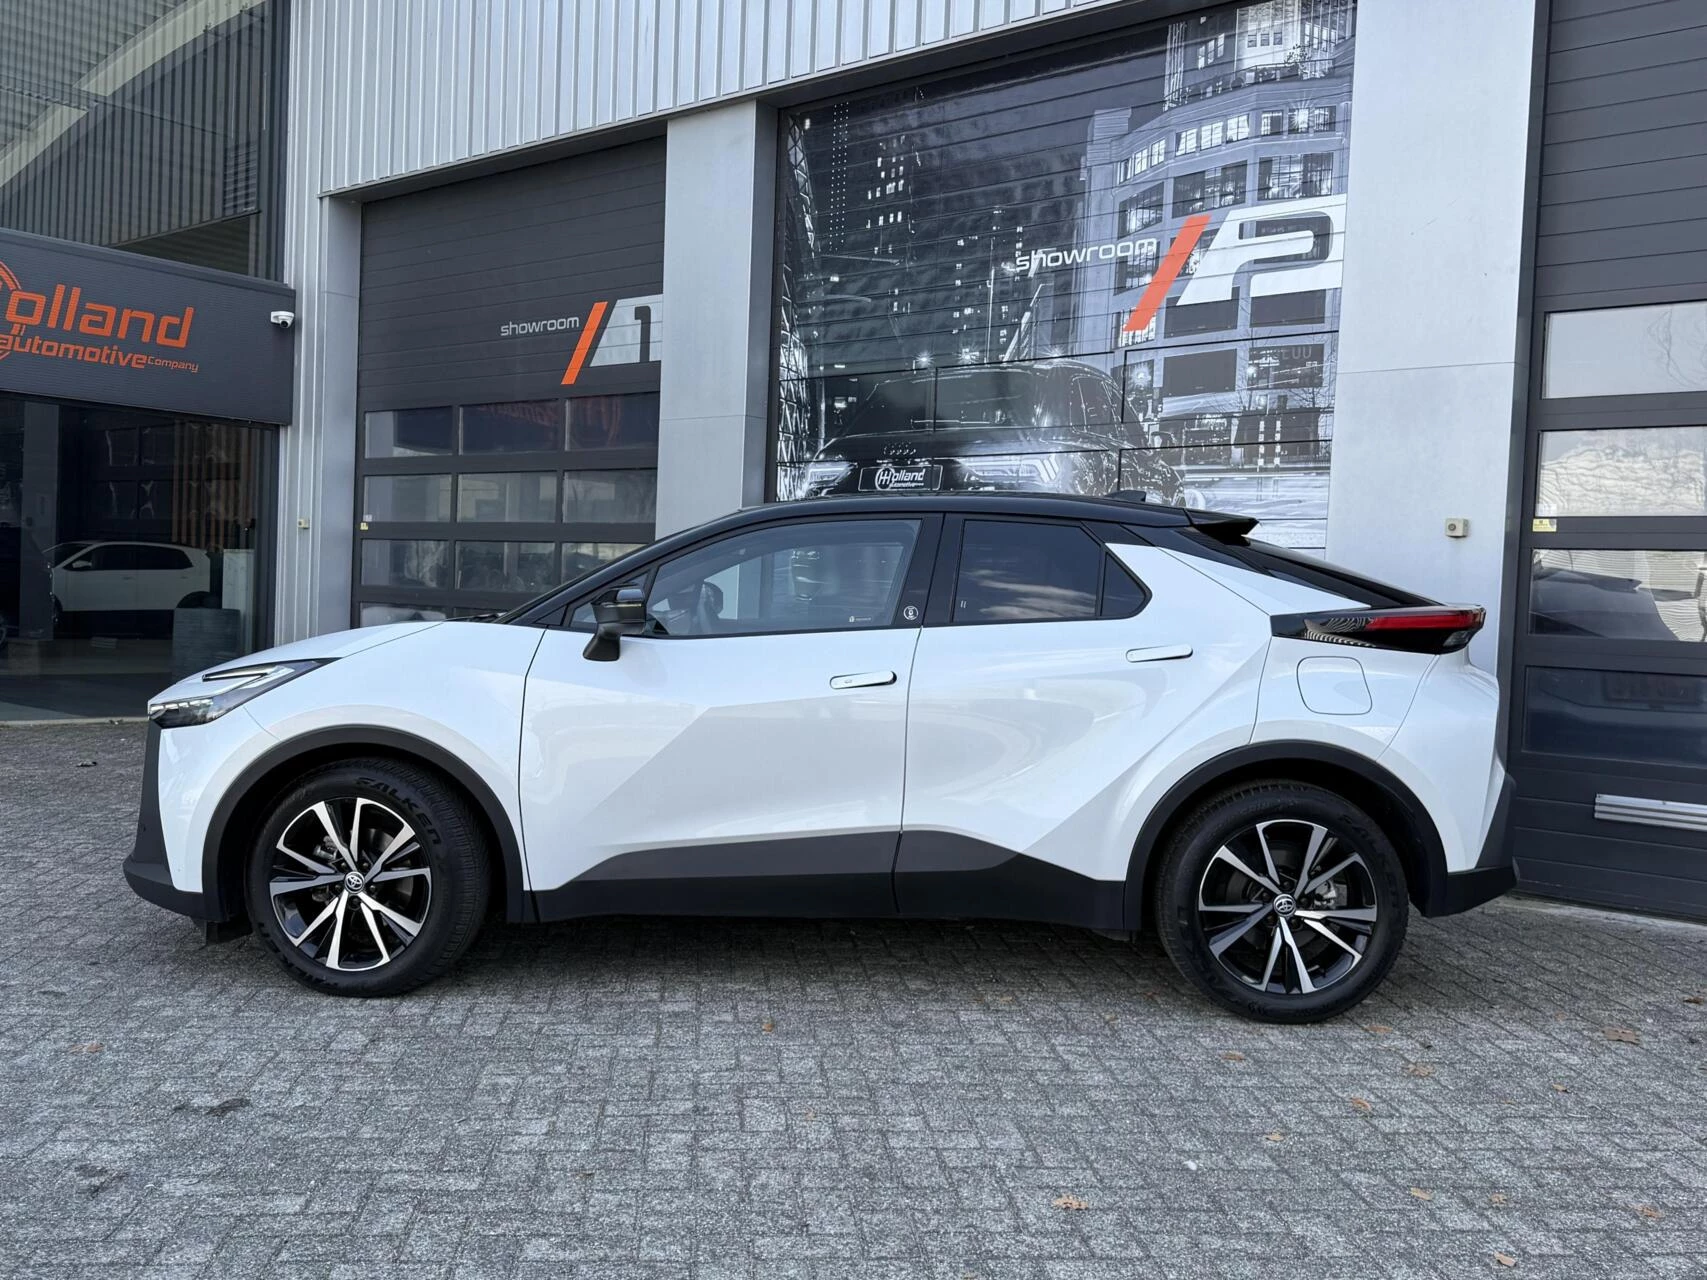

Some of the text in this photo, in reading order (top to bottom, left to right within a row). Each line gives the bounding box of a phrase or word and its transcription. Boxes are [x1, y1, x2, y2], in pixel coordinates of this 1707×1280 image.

[1015, 237, 1158, 272] showroom
[2, 283, 195, 349] olland
[500, 316, 580, 336] showroom
[0, 333, 199, 373] automotive Company
[355, 776, 442, 846] FALKEN
